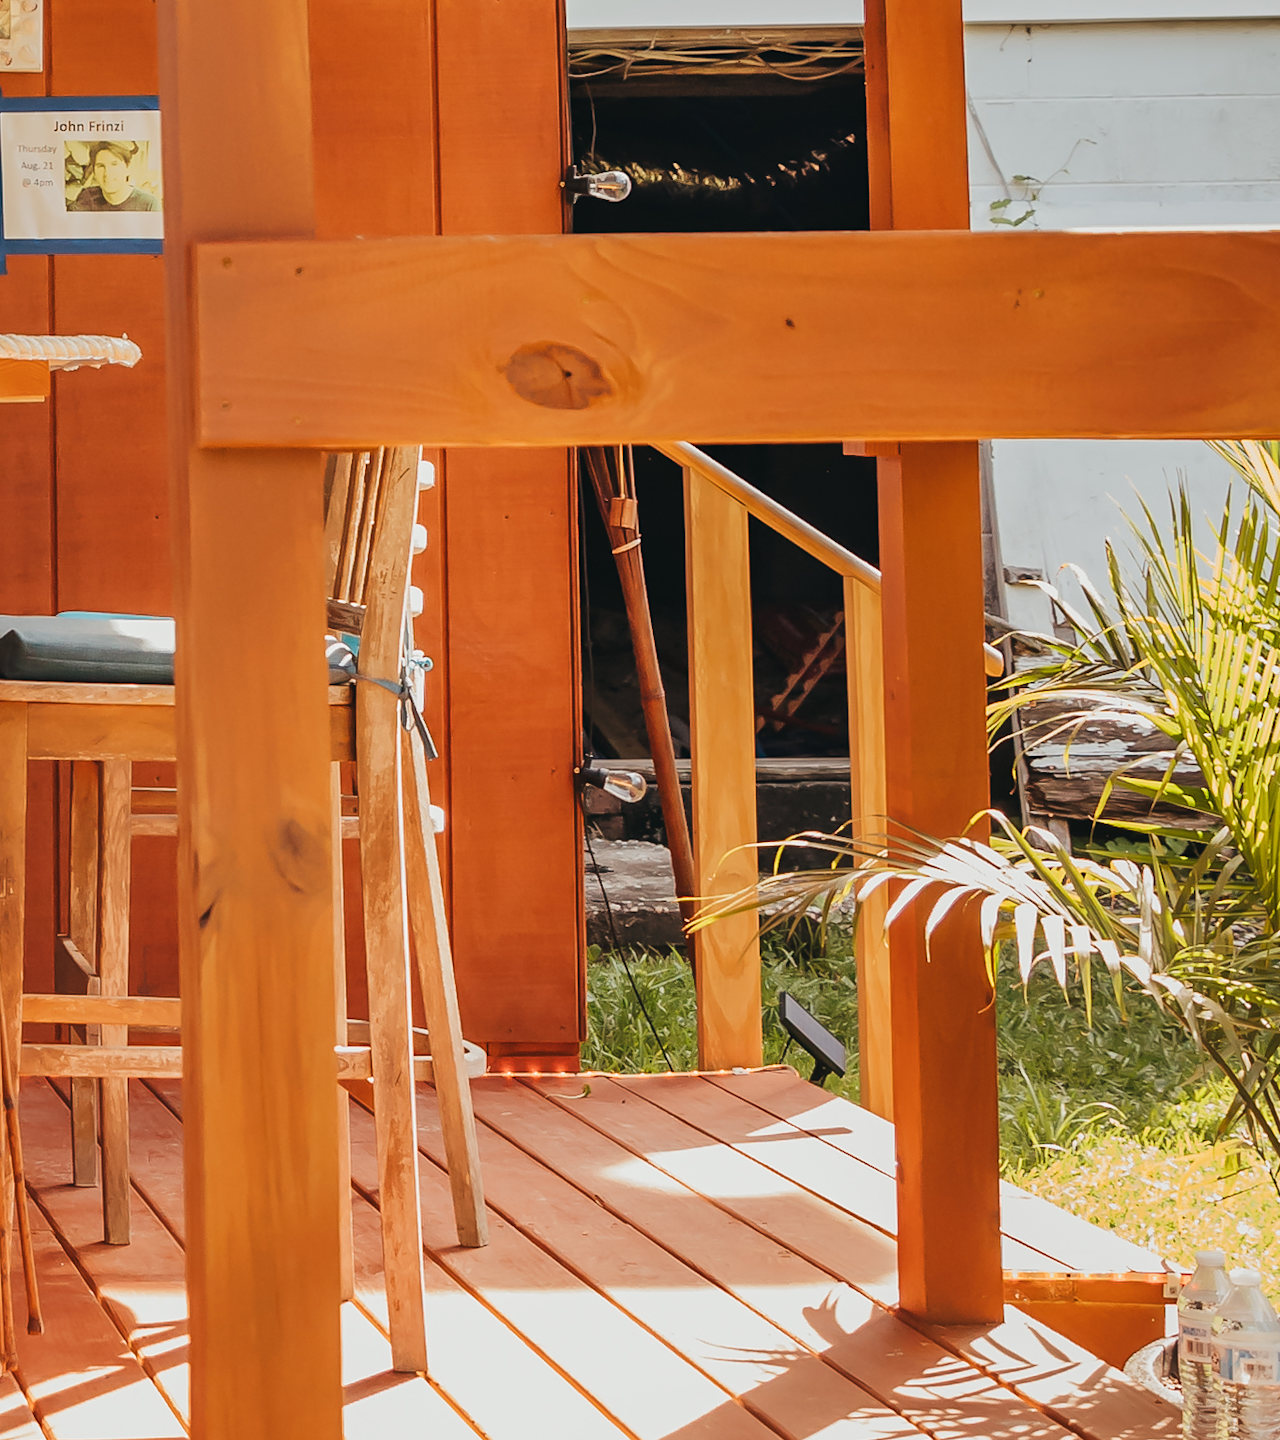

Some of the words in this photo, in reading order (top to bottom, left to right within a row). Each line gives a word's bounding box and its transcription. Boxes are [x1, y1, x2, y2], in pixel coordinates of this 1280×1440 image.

[53, 120, 84, 133] John
[88, 120, 125, 132] Frinzi
[17, 144, 57, 155] Thursday
[20, 161, 41, 171] Aug.
[43, 161, 54, 170] 21
[21, 178, 32, 188] @
[33, 178, 54, 188] 4pm
